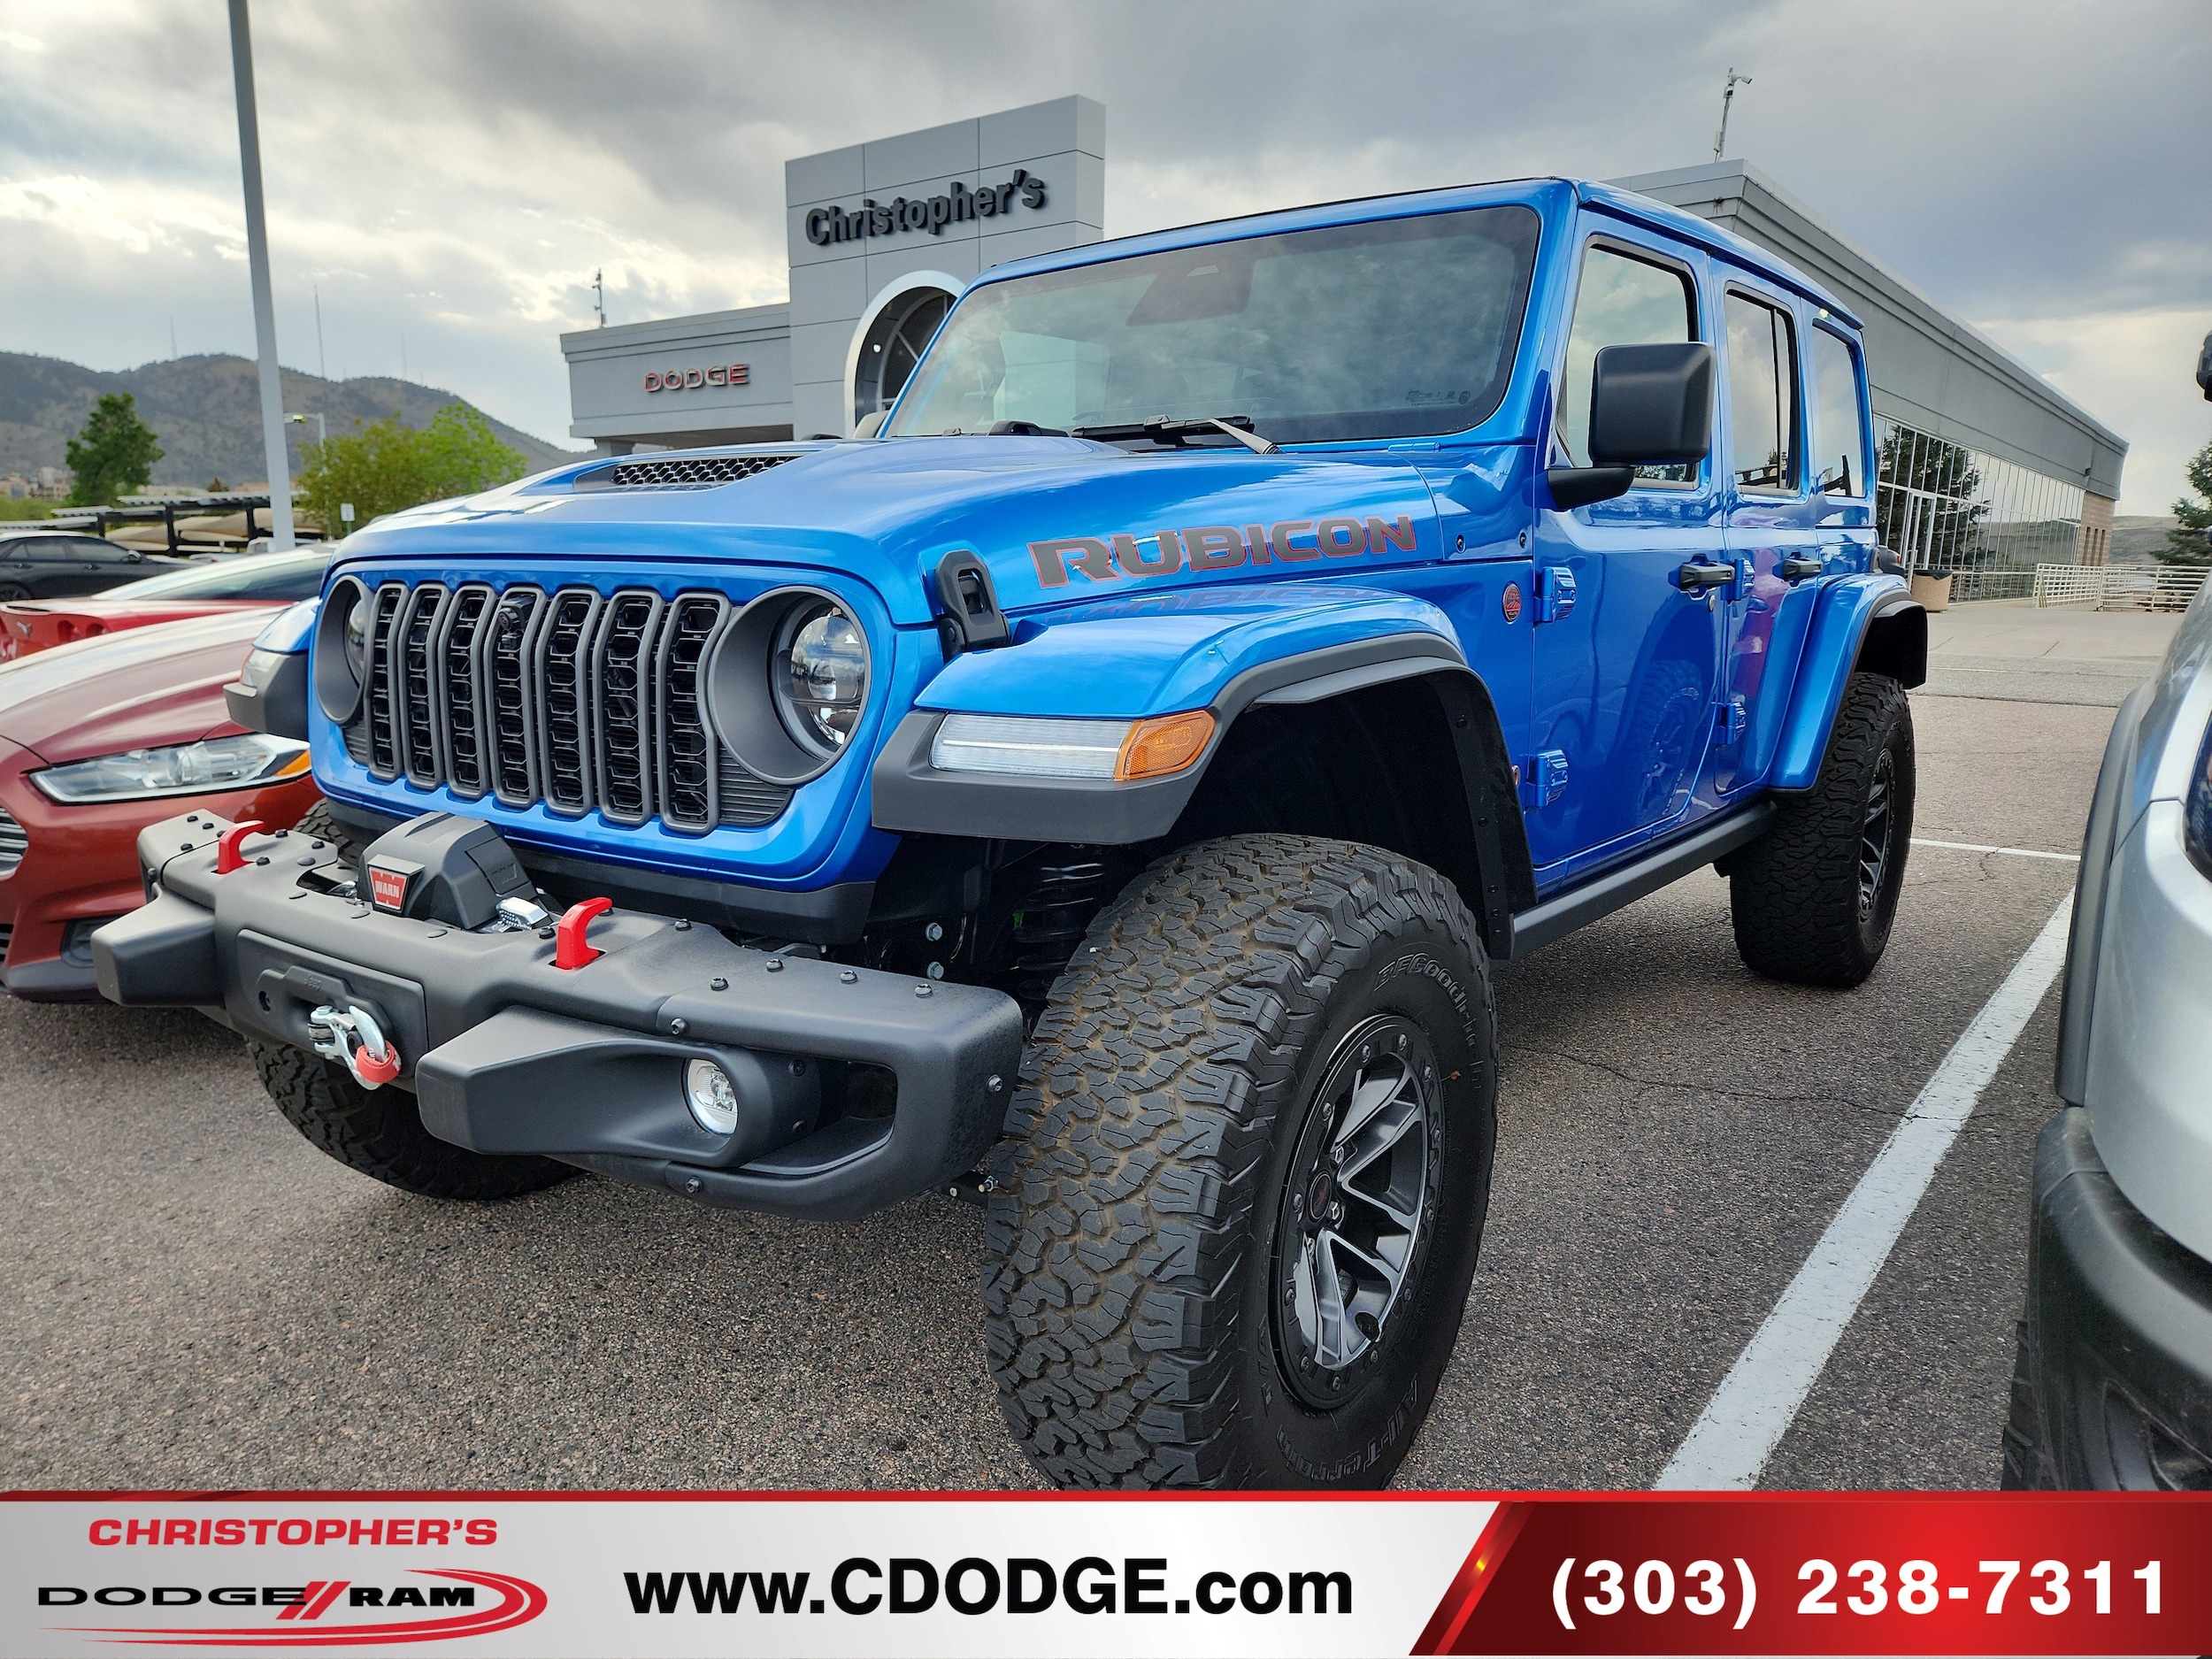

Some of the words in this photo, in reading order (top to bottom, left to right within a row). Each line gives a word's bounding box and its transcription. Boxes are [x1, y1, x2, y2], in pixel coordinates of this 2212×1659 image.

[805, 168, 1046, 246] Christopher's
[644, 363, 750, 392] DODGE
[1026, 514, 1417, 589] RUBICON
[374, 879, 400, 899] WARN
